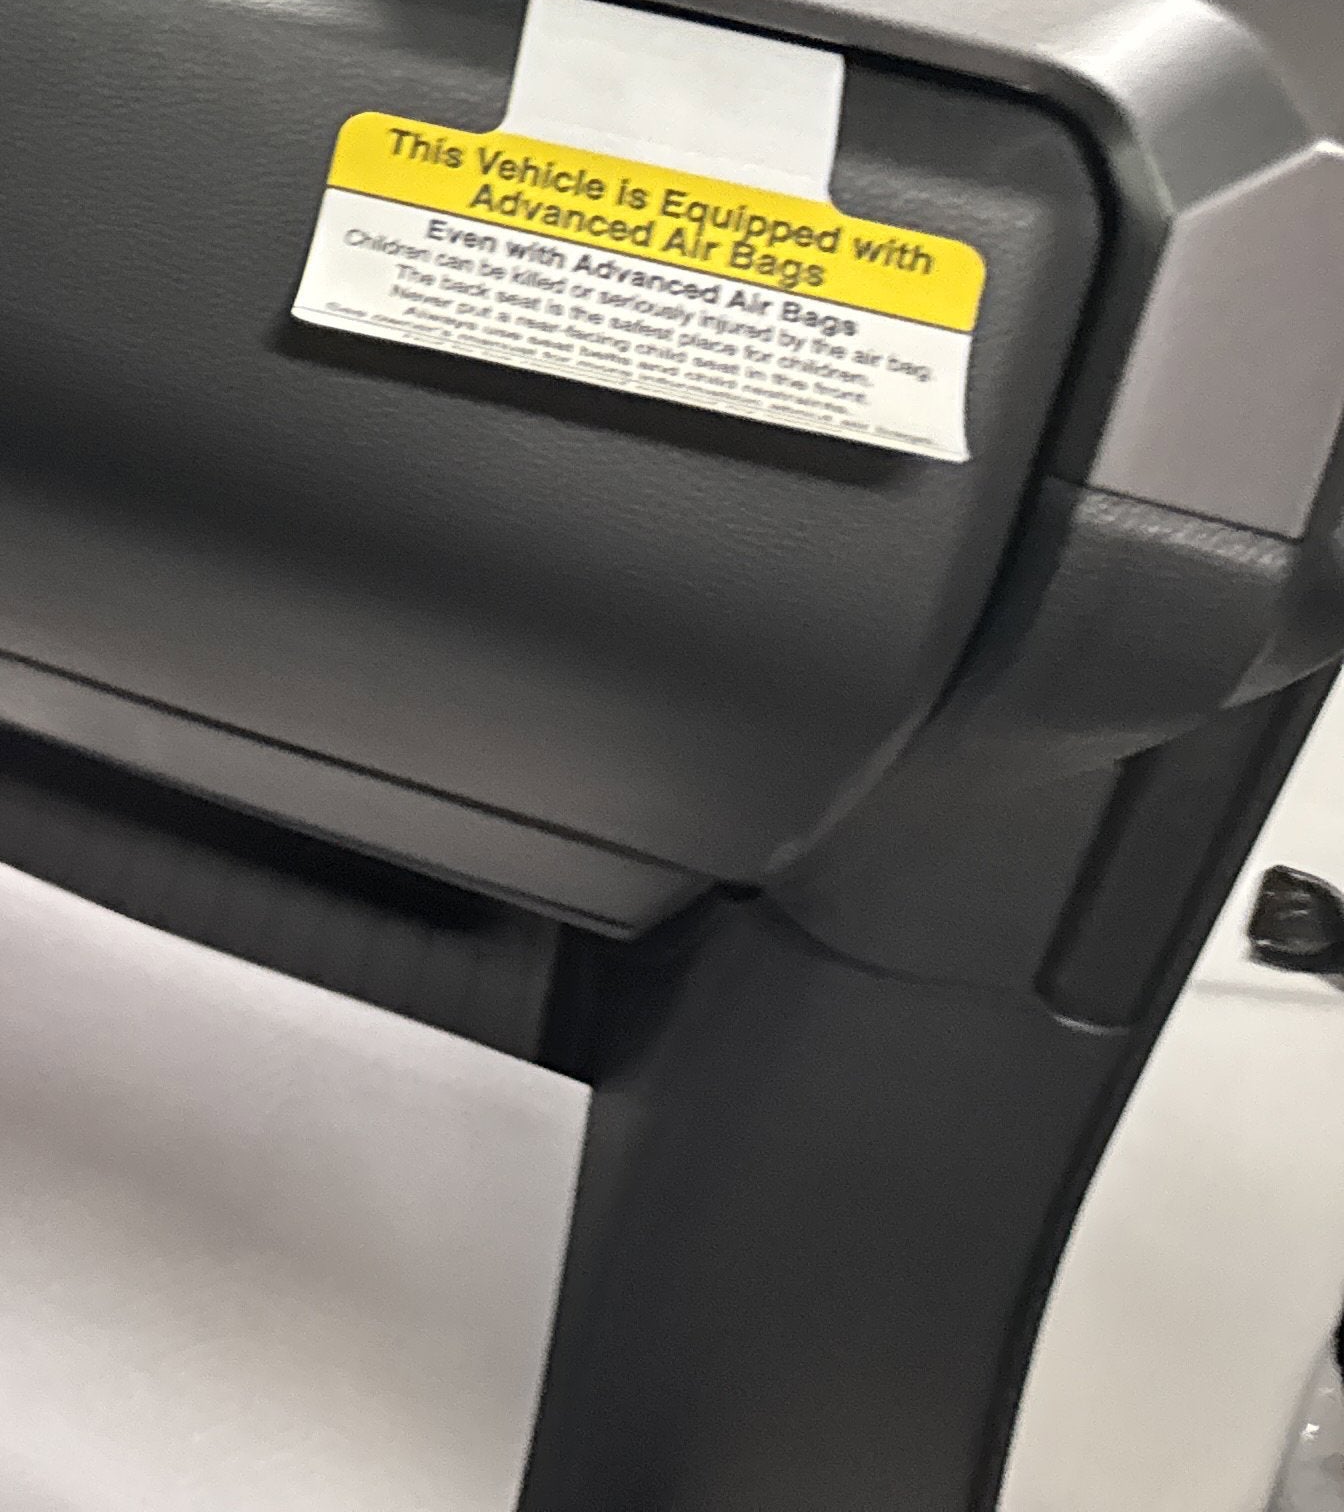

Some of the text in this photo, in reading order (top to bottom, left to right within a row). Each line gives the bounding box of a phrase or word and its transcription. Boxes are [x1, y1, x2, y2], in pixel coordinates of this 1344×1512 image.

[388, 128, 934, 275] This Vehicle is Equipped with
[468, 184, 827, 288] Advanced Air Bags
[344, 228, 431, 263] Children
[434, 253, 473, 273] can
[478, 259, 507, 281] be
[510, 266, 567, 295] killed
[570, 284, 595, 299] or
[597, 291, 695, 327] seriously
[697, 310, 774, 343] injured
[777, 328, 807, 353] by
[811, 338, 847, 360] the
[851, 350, 883, 367] air
[425, 219, 857, 338] Even with Advanced Air Bags
[569, 305, 604, 326] the
